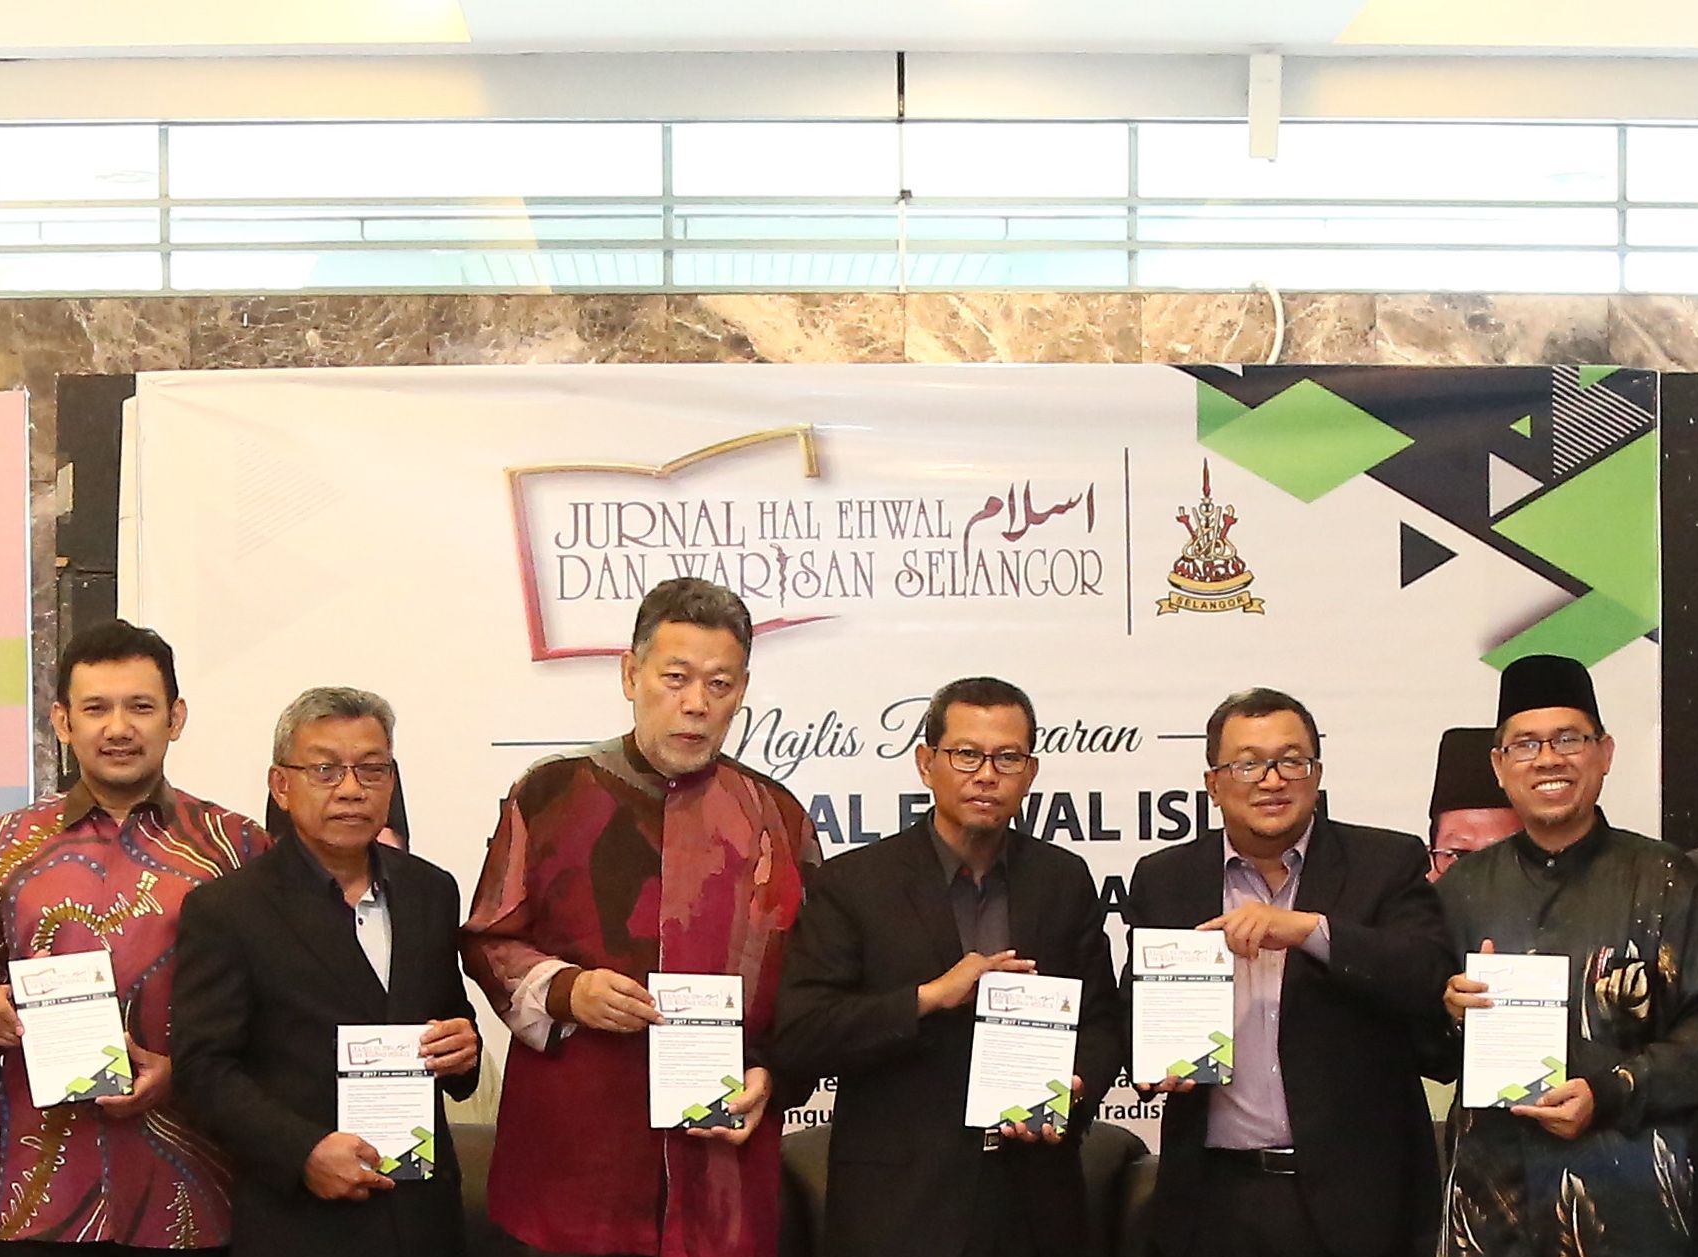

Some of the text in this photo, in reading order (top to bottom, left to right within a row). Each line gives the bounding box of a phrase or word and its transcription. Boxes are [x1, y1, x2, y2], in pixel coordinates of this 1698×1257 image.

[554, 500, 952, 550] JURNAL HAL EHWAL
[558, 553, 647, 601] DAN
[896, 549, 1103, 598] SELANGOR
[1176, 596, 1247, 610] SELANGOR
